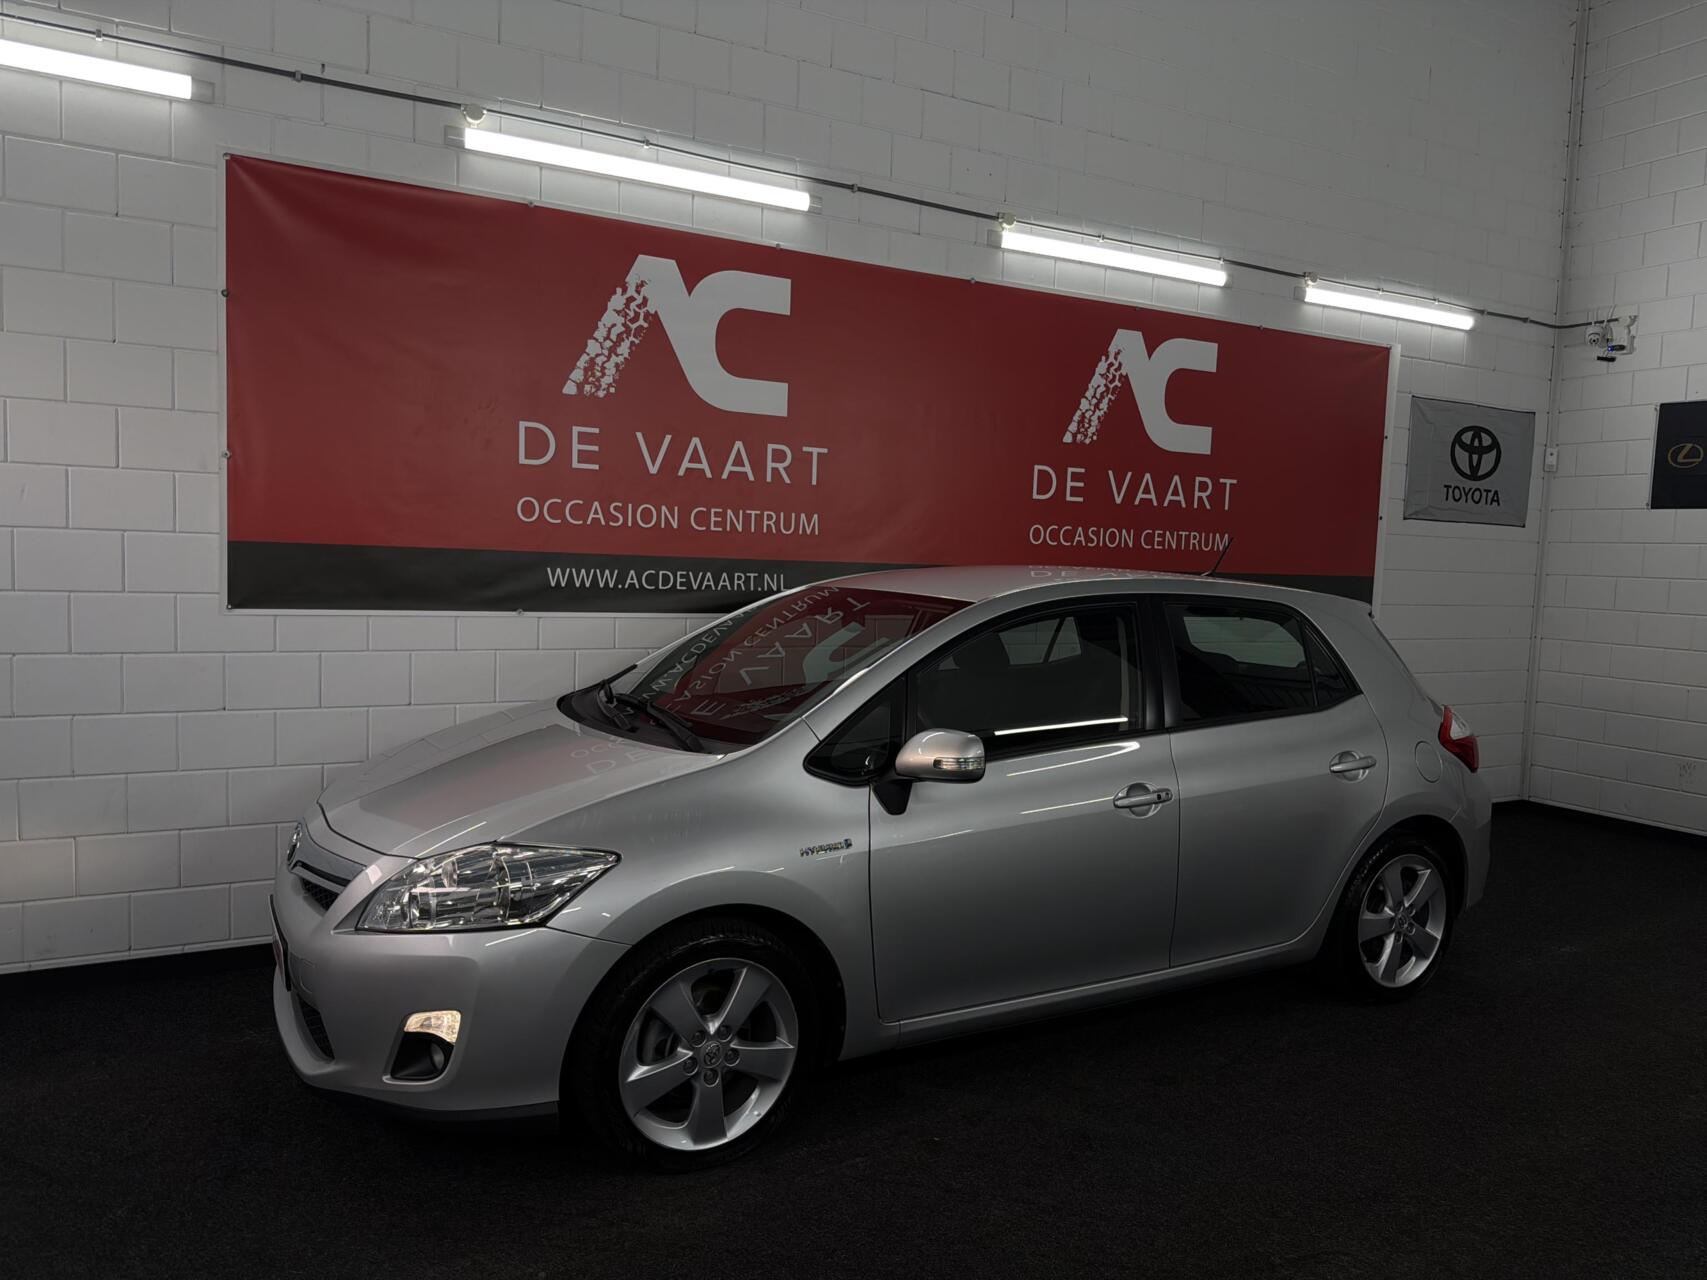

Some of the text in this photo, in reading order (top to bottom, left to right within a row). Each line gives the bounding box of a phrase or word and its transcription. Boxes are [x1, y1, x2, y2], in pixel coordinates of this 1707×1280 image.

[518, 420, 828, 486] DE VAART
[1032, 464, 1238, 511] DE VAART
[1443, 484, 1501, 506] TOYOTA
[516, 496, 820, 536] OCCASION CENTRUM
[1029, 524, 1230, 552] OCCASION CENTRUM
[546, 567, 789, 592] WWW.ACDEVAART.NL
